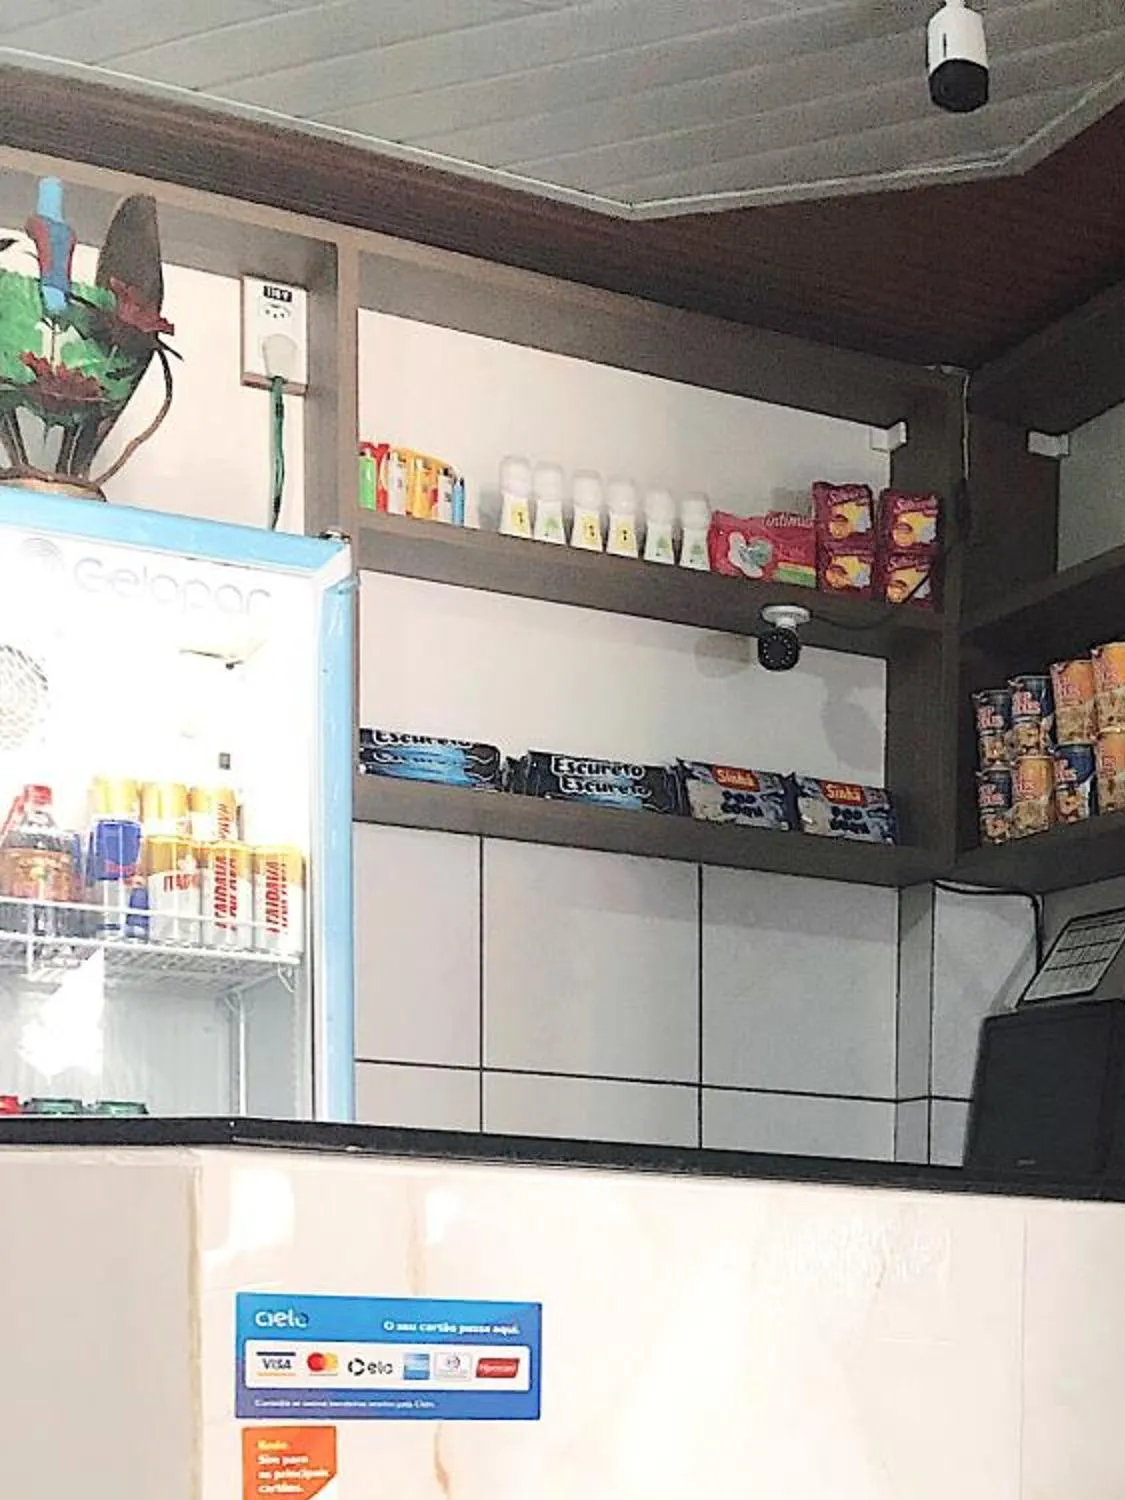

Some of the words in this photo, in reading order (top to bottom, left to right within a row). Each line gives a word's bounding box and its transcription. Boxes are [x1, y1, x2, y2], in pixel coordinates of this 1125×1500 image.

[554, 756, 644, 777] Escureto
[383, 1320, 395, 1332] O
[262, 1358, 292, 1371] VISA
